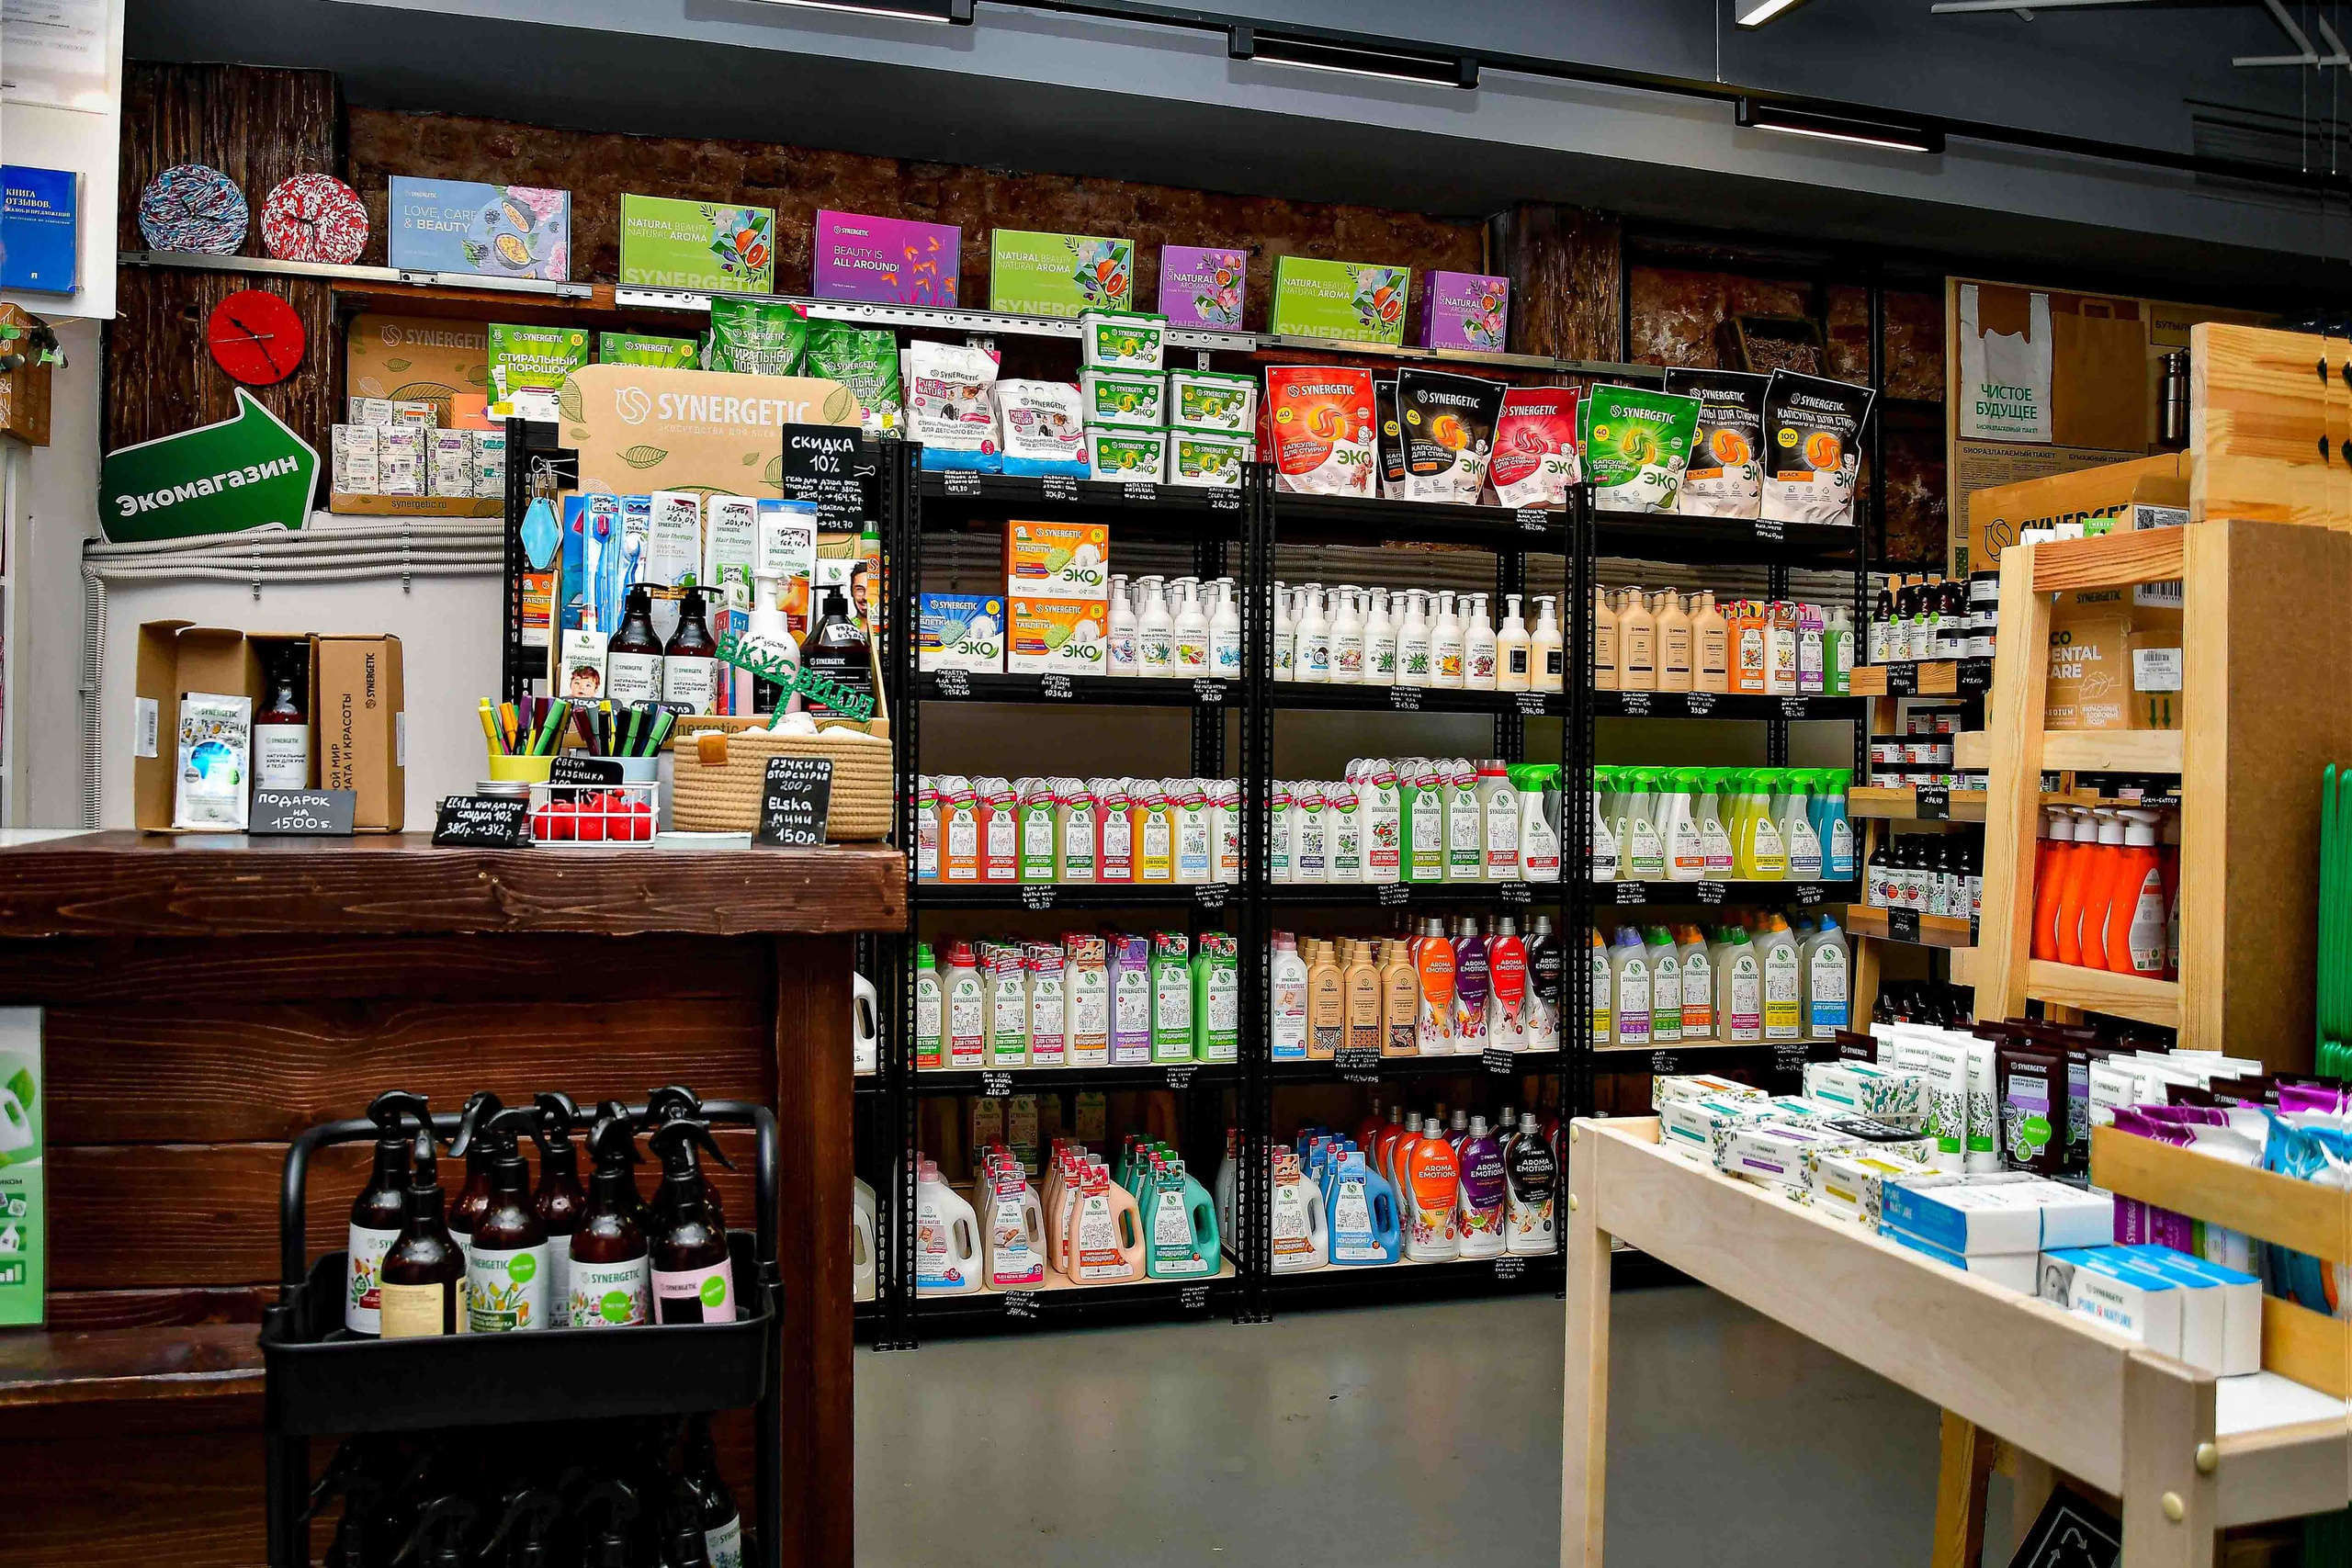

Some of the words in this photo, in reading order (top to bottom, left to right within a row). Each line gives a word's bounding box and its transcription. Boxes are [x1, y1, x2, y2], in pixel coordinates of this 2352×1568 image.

[6, 188, 36, 198] КНИГА
[403, 205, 440, 220] LOVE,
[444, 209, 478, 221] CARE
[403, 219, 413, 229] &
[417, 220, 471, 233] BEAUTY
[628, 218, 673, 230] NATURAL
[674, 221, 709, 233] BEAUTY
[628, 227, 669, 240] NATURAL
[670, 231, 707, 243] AROMA
[834, 246, 872, 258] BEAUTY
[874, 250, 883, 259] IS
[998, 252, 1039, 263] NATURAL
[1040, 254, 1072, 265] BEAUTY
[833, 257, 852, 270] ALL
[854, 259, 899, 273] AROUND!
[998, 260, 1035, 270] NATURAL
[1036, 264, 1071, 274] AROMA
[626, 267, 769, 293] SYNERGETIC
[1174, 274, 1214, 284] NATURAL
[1283, 277, 1321, 288] NATURAL
[1323, 281, 1351, 291] BEAUTY
[1180, 281, 1214, 290] AROMATIC
[1282, 287, 1317, 297] NATURAL
[1317, 289, 1351, 299] AROMA
[1444, 298, 1481, 309] NATURAL
[522, 333, 563, 344] SYNERGETIC
[634, 342, 673, 355] SYNERGETIC
[724, 344, 794, 365] СТИРАЛЬНЫЙ
[498, 353, 578, 366] СТИРАЛЬНЫЙ
[1135, 353, 1156, 363] ЭКО
[508, 363, 568, 375] ПОРОШОК
[733, 359, 781, 375] ПОРОШОК
[940, 370, 978, 380] SYNERGETIC
[919, 388, 945, 398] NATURE
[1301, 385, 1355, 397] SYNERGETIC
[1702, 389, 1745, 402] SYNERGETIC
[1981, 384, 2031, 401] ЧИСТОЕ
[1031, 400, 1067, 411] SYNERGETIC
[1430, 392, 1480, 409] SYNERGETIC
[1801, 395, 1846, 412] SYNERGETIC
[659, 393, 809, 427] SYNERGETIC
[1011, 410, 1025, 418] PURE
[1134, 409, 1156, 418] ЭКО
[1279, 410, 1290, 418] 40
[1509, 405, 1558, 416] SYNERGETIC
[1622, 406, 1676, 424] SYNERGETIC
[1976, 401, 2038, 421] БУДУЩЕЕ
[1218, 413, 1238, 422] ЭКО
[1409, 412, 1419, 421] 40
[918, 420, 958, 429] СТИРАЛЬНЫЙ
[1781, 433, 1796, 441] 100
[791, 436, 854, 455] СКИДКА
[1283, 441, 1317, 453] КАПСУЛЫ
[1411, 445, 1444, 453] КАПСУЛЫ
[1283, 450, 1298, 458] ДЛЯ
[1299, 446, 1329, 456] СТИРКИ
[1336, 450, 1370, 465] ЭКО
[1425, 452, 1453, 460] СТИРКИ
[1962, 447, 2030, 458] БИОРАЗЛАГАЕМЫЙ
[2032, 451, 2055, 459] ПАКЕТ
[809, 455, 840, 473] 10%
[1491, 455, 1526, 465] КАПСУЛЫ
[2068, 454, 2109, 463] БУМАЖНЫЙ
[1135, 465, 1157, 474] ЭКО
[1216, 468, 1238, 477] ЭКО
[1609, 464, 1636, 472] СТИРКИ
[115, 455, 300, 516] Экомагазин
[1644, 472, 1678, 491] ЭКО
[391, 499, 447, 509] synergetic.ru
[670, 533, 694, 541] Therapy
[1045, 529, 1082, 538] SYNERGETIC
[786, 560, 808, 569] Therapy
[1062, 570, 1097, 582] ЭКО
[2076, 590, 2121, 604] SYNERGETIC
[939, 601, 977, 610] SYNERGETIC
[1045, 605, 1081, 614] SYNERGETIC
[716, 617, 727, 629] 1+1
[733, 617, 746, 630] 1+1
[2051, 631, 2071, 645] CO
[957, 641, 993, 655] ЭКО
[1062, 645, 1097, 659] ЭКО
[2052, 646, 2101, 661] ENTAL
[2051, 663, 2082, 679] ARE
[556, 758, 584, 768] СВЕЧА
[771, 760, 813, 771] РУЧКИ
[817, 761, 831, 771] ИЗ
[555, 769, 604, 781] КЛУБНИКА
[767, 770, 828, 781] ВТОРСЫРЬЯ
[258, 794, 331, 807] ПОДАРОК
[447, 797, 471, 809] Elska
[293, 808, 309, 817] НА
[458, 810, 492, 824] СКИДКА
[494, 811, 512, 822] 10%
[271, 818, 318, 829] 1500
[1847, 1045, 1868, 1056] SYNERGETIC
[2018, 1063, 2047, 1074] SYNERGETIC
[2027, 1127, 2048, 1136] ТЕСТЕР
[1476, 1162, 1502, 1171] AROMA
[1516, 1164, 1554, 1172] EMOTIONS
[1522, 1158, 1550, 1167] AROMA
[1419, 1170, 1456, 1179] EMOTIONS
[1471, 1168, 1506, 1178] EMOTIONS
[1080, 1254, 1116, 1262] КОНДИЦИОНЕР
[1157, 1249, 1191, 1258] КОНДИЦИОНЕР
[591, 1269, 640, 1284] SYNERGETIC
[2077, 1297, 2095, 1317] PURE
[2104, 1307, 2132, 1329] NATURE
